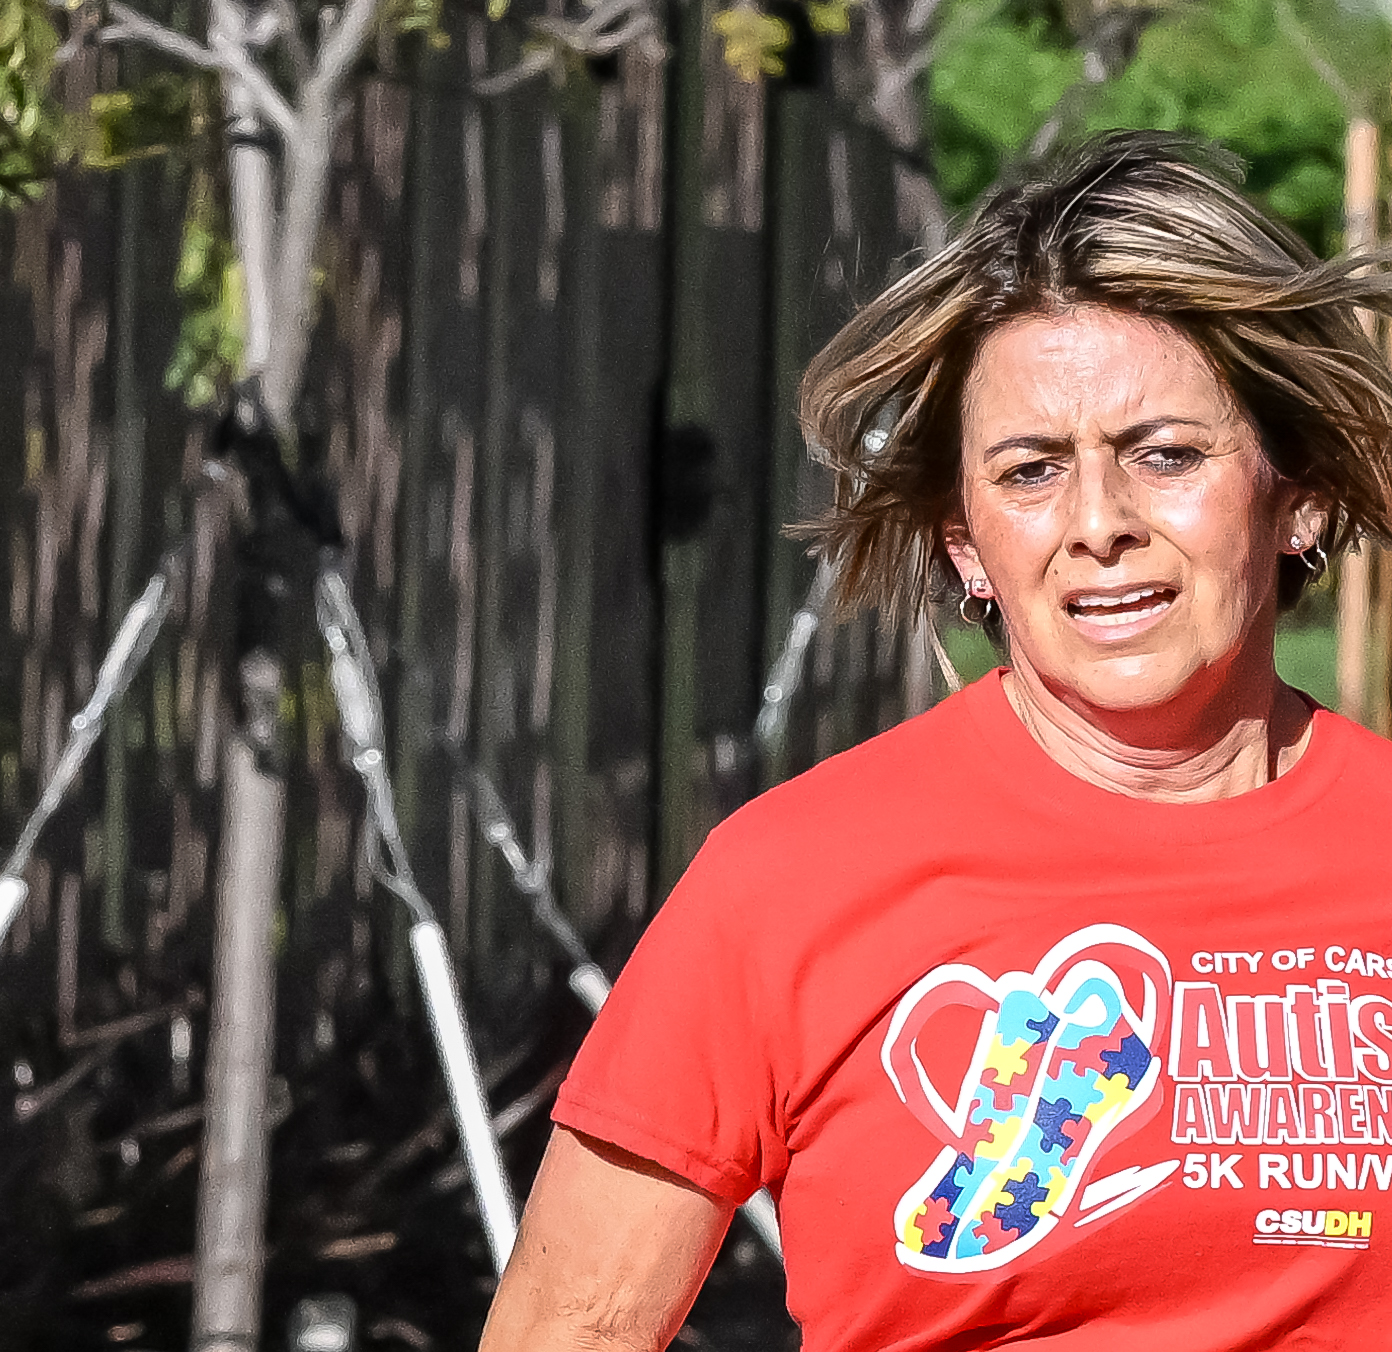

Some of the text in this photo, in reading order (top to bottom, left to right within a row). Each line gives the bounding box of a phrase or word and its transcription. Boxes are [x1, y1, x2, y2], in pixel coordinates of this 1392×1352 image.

[1191, 951, 1265, 974] CITY
[1271, 948, 1316, 970] OF
[1182, 1152, 1244, 1190] 5K
[1255, 1209, 1372, 1237] CSUDH
